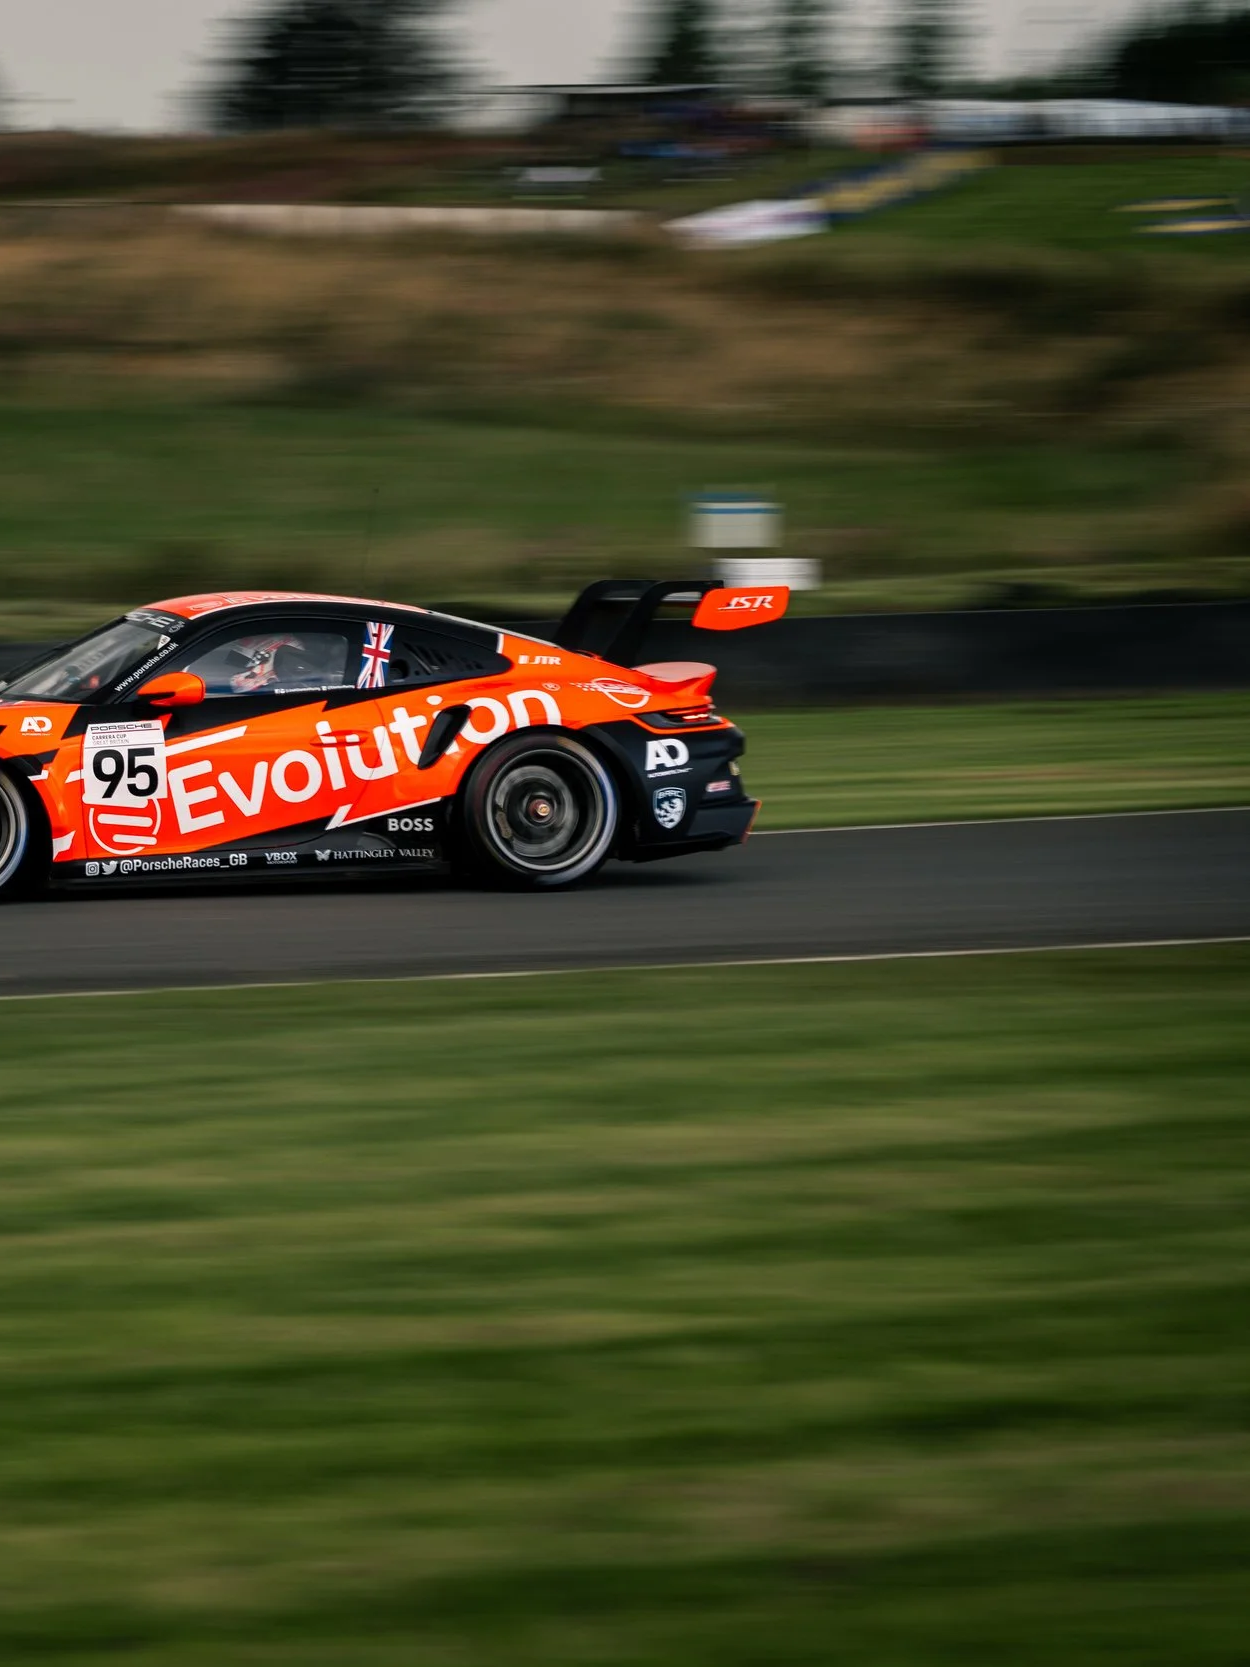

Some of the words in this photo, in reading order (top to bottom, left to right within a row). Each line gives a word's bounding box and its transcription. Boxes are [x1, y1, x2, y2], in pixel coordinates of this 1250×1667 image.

[114, 642, 179, 692] www.porsche.co.uk
[20, 716, 53, 733] AD
[91, 723, 152, 731] PORSCHE
[645, 738, 690, 771] AD
[93, 747, 159, 799] 95
[387, 818, 434, 832] BOSS
[264, 851, 298, 861] VBOX
[333, 849, 396, 860] HATTINGLEY
[398, 848, 434, 858] VALLEY
[120, 853, 248, 874] @PorscheRaces_GB
